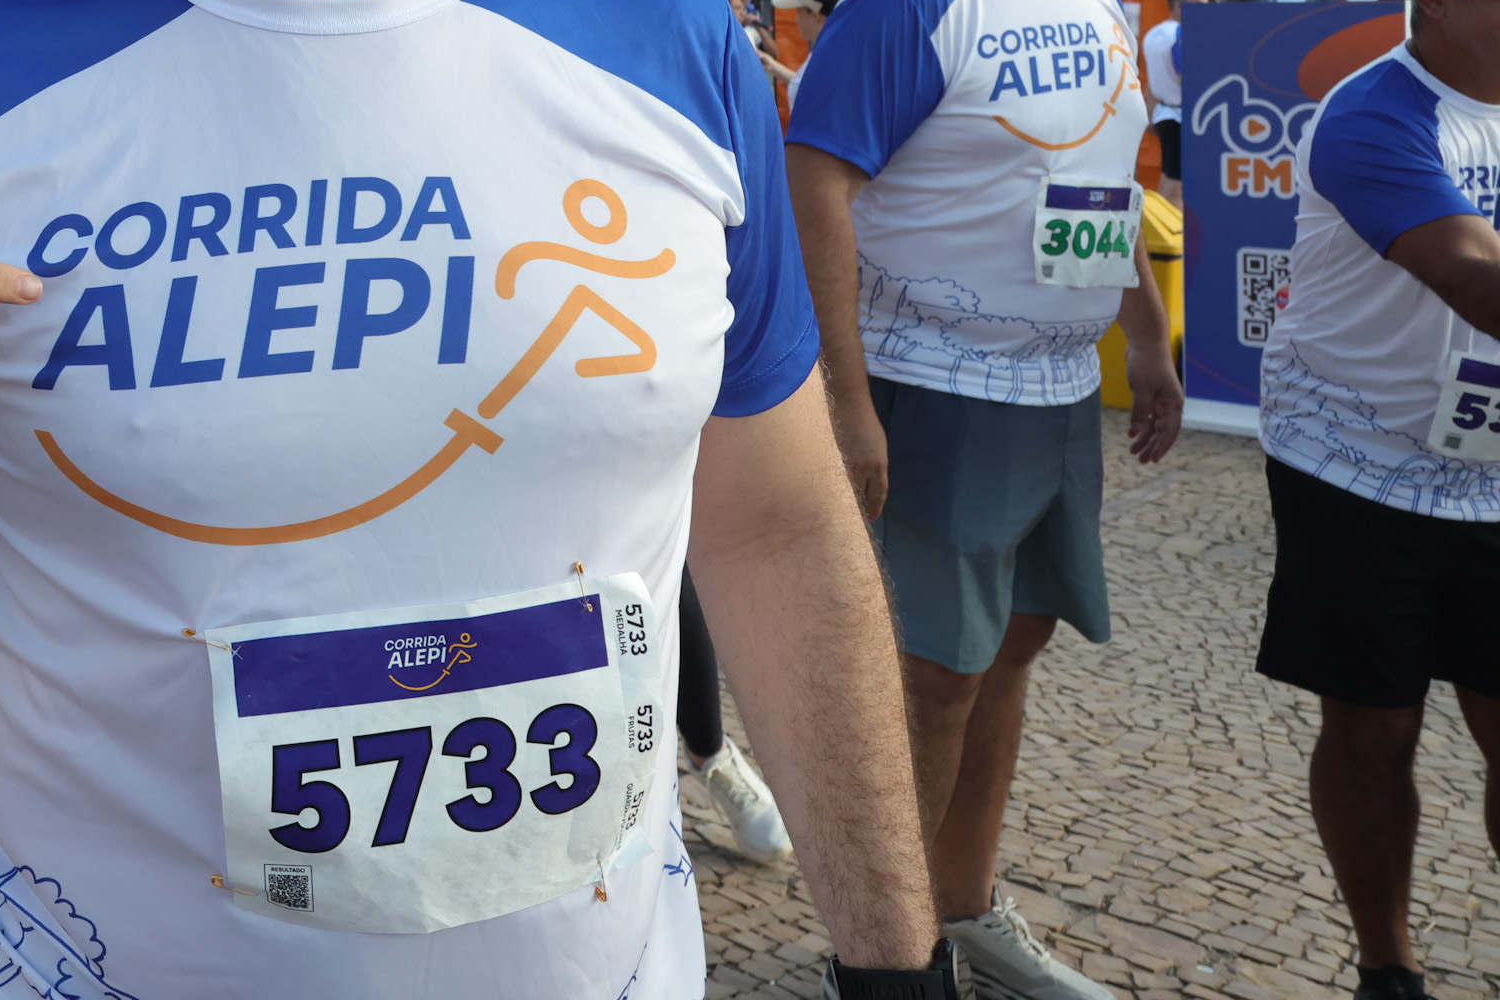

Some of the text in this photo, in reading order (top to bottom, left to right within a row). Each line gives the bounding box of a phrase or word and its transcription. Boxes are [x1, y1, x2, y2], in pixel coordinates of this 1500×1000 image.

[977, 22, 1101, 59] CORRIDA
[988, 49, 1106, 102] ALEPI
[26, 176, 472, 278] CORRIDA
[1041, 218, 1130, 260] 3044
[31, 256, 475, 391] ALEPI
[384, 634, 446, 651] CORRIDA
[615, 609, 628, 656] MEDALHA
[625, 604, 648, 656] 5733
[387, 646, 447, 669] ALEPI
[627, 715, 636, 749] FRUTAS
[637, 704, 653, 753] 5733
[268, 703, 601, 853] 5733
